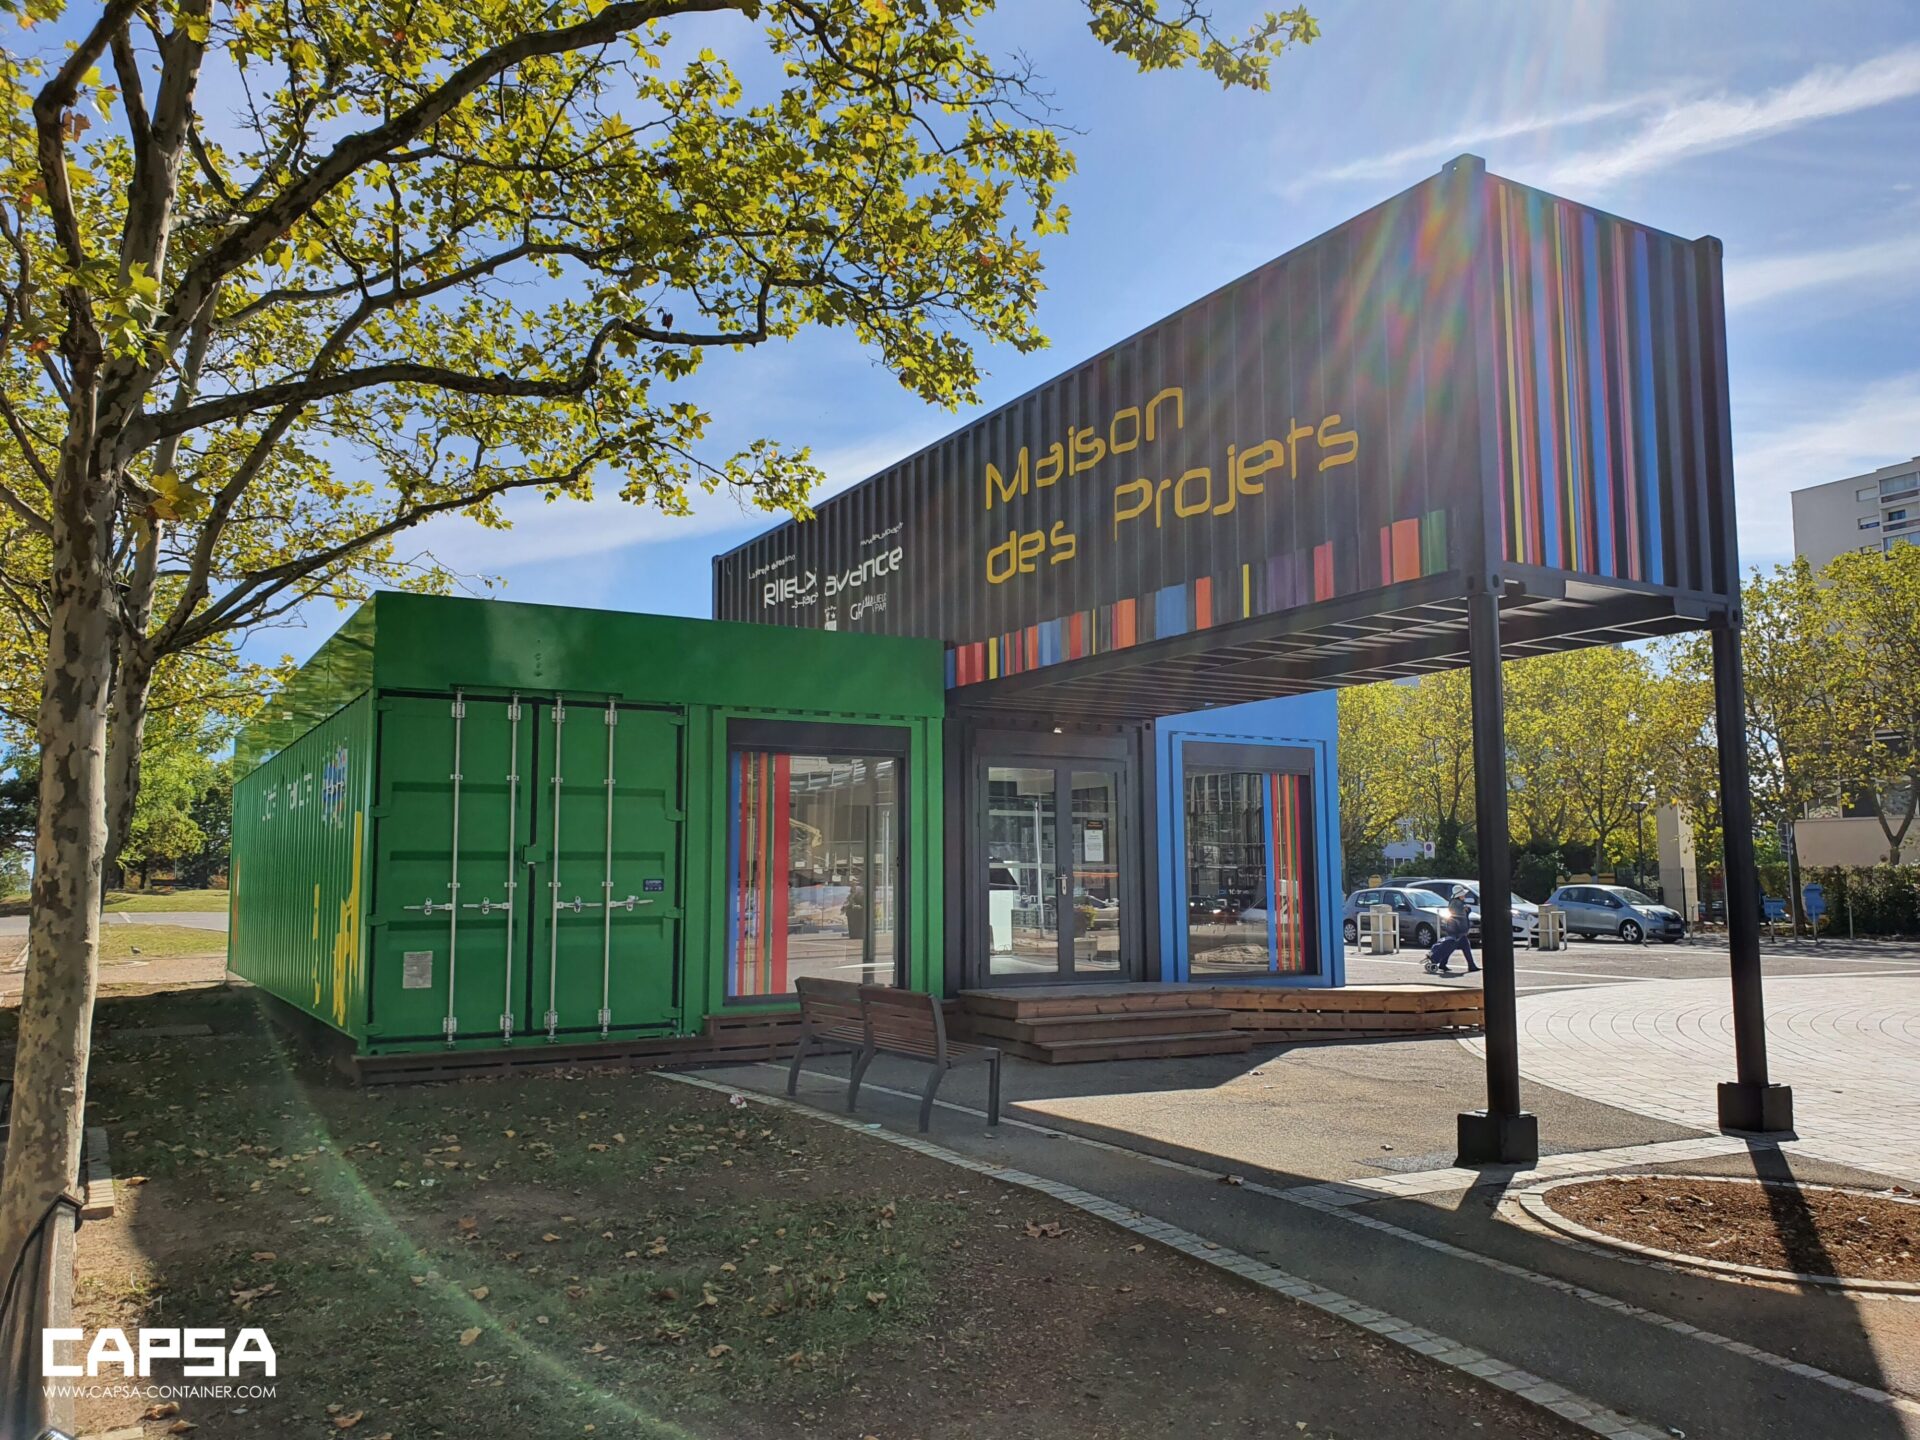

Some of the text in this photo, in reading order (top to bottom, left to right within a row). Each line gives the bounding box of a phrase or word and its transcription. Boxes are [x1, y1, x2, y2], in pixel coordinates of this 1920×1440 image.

[985, 387, 1184, 510] Maison
[986, 413, 1359, 584] des Projets
[824, 546, 903, 597] avance
